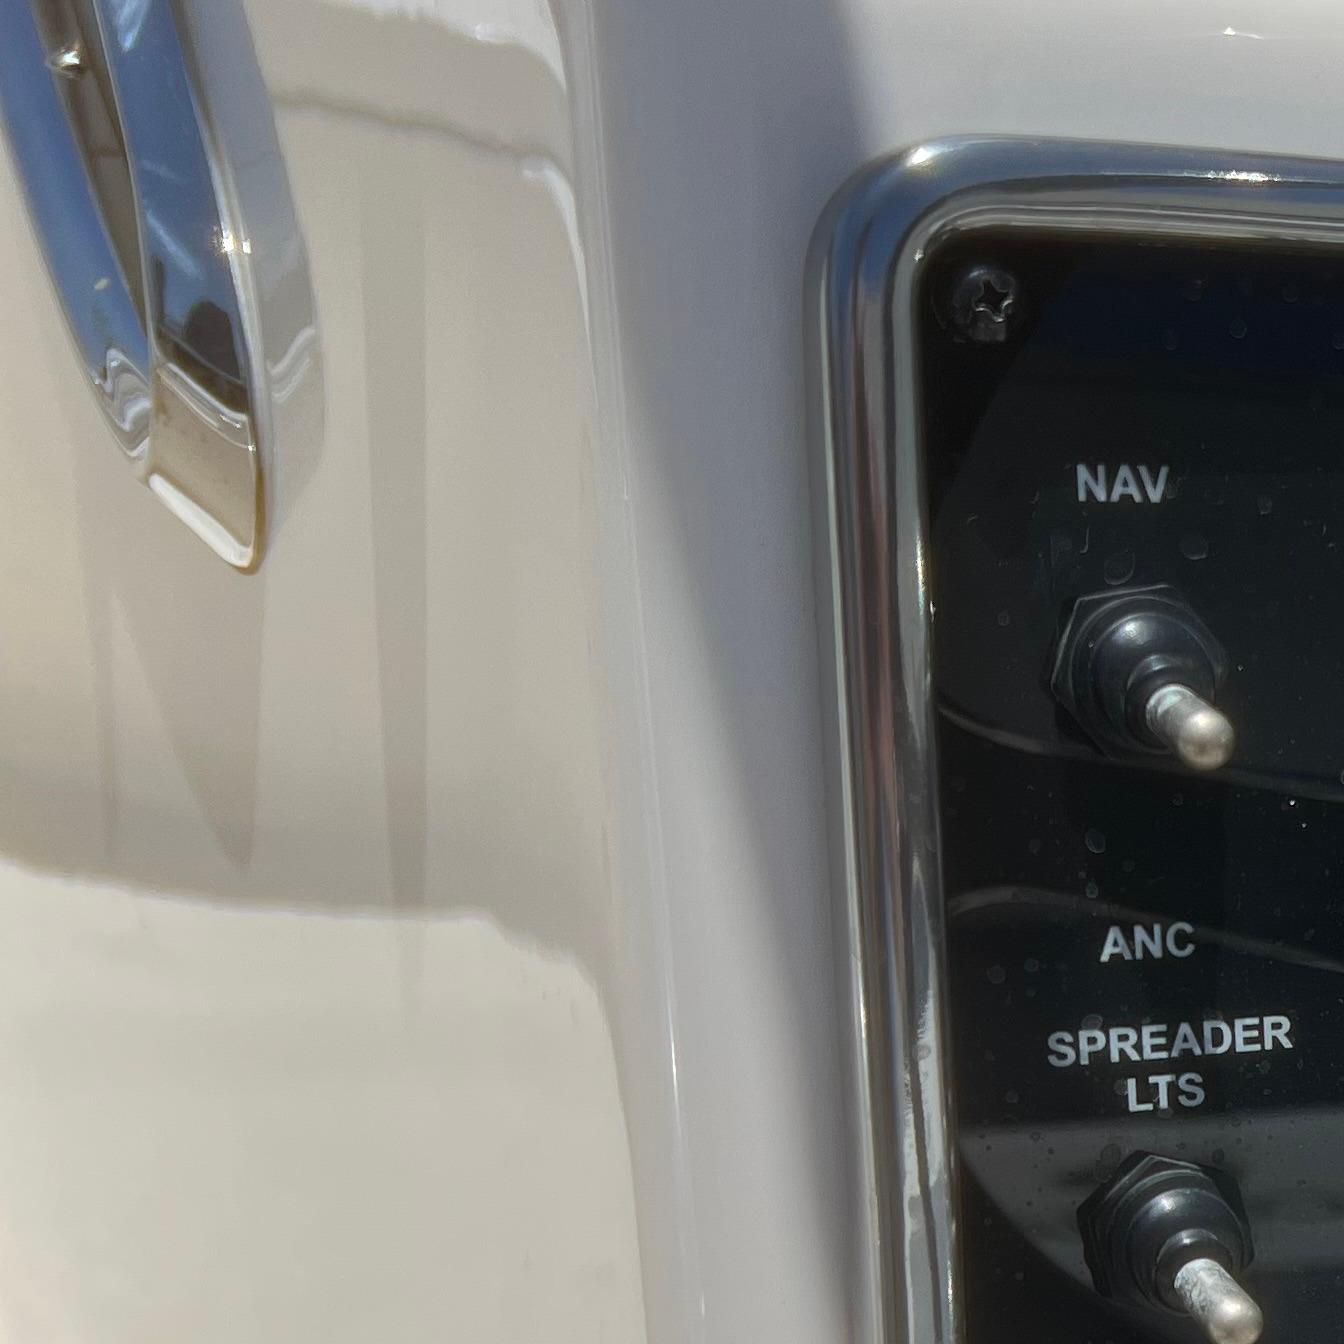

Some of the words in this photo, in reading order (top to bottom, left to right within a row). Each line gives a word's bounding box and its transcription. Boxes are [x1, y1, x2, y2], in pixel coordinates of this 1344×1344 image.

[1075, 464, 1170, 504] NAV
[1100, 921, 1197, 963] ANC
[1046, 1014, 1293, 1068] SPREADER
[1126, 1071, 1207, 1113] LTS
